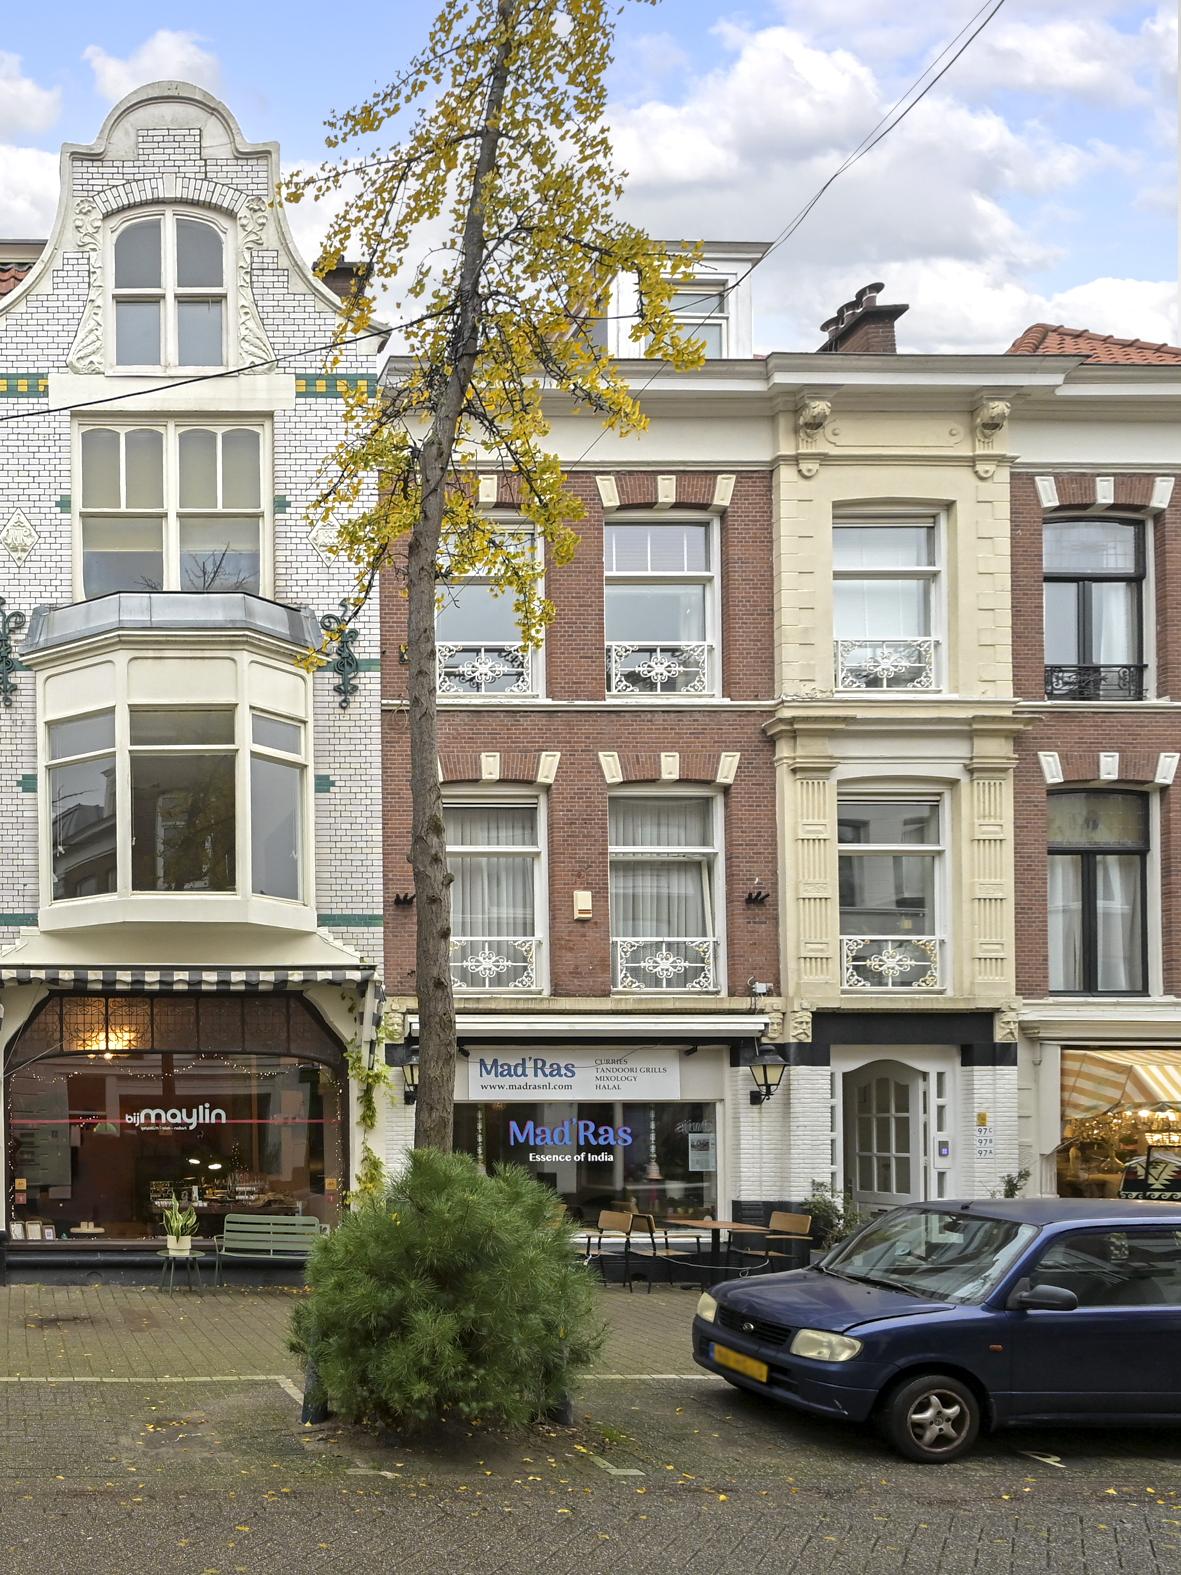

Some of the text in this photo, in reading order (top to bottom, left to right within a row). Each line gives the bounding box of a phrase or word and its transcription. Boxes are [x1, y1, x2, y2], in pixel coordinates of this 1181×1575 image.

[479, 1056, 576, 1078] Mad'Ras
[594, 1058, 628, 1066] CURRIES
[480, 1081, 573, 1091] www.madrasnl.com
[140, 1102, 227, 1130] maylin
[509, 1117, 633, 1146] Mad'Ras
[529, 1151, 614, 1162] Essence of India
